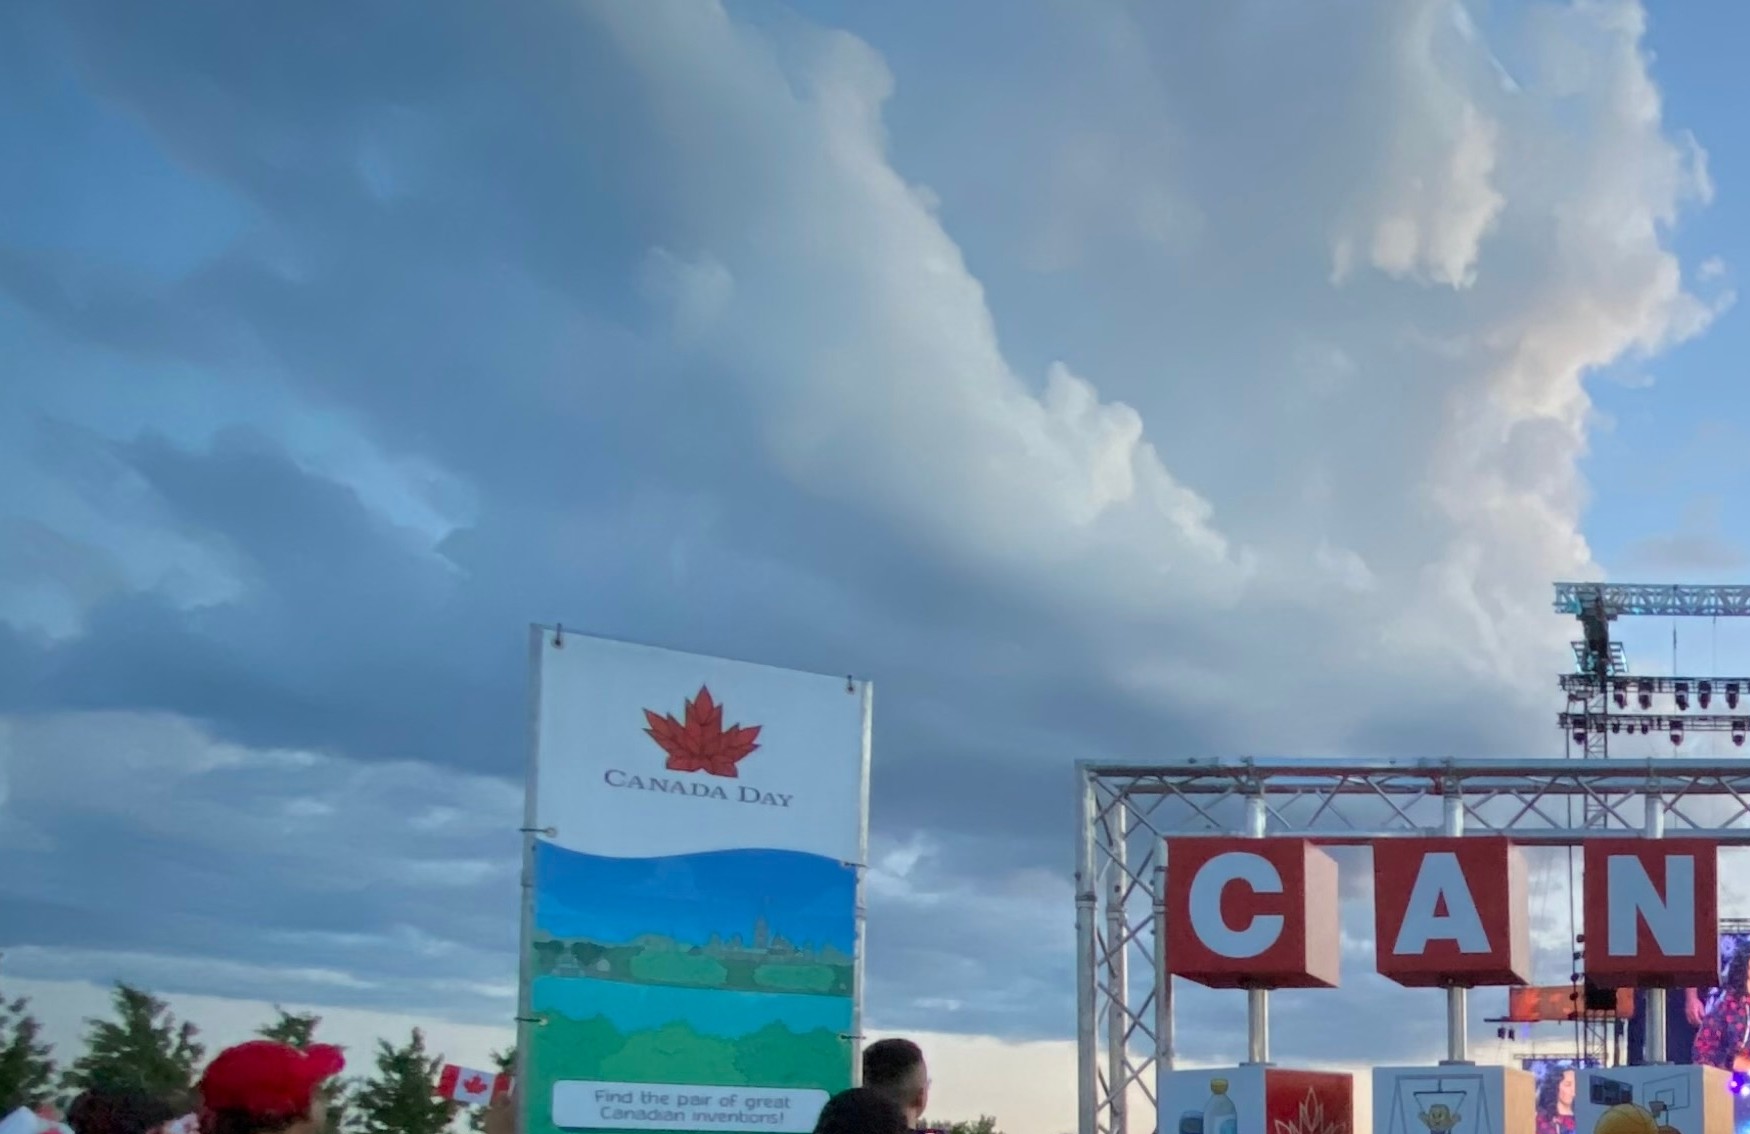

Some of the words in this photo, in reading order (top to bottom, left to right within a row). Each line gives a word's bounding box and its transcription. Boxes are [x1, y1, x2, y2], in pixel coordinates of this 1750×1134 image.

[603, 768, 727, 801] CANADA
[737, 785, 794, 808] DAY
[594, 1089, 632, 1105] Find
[640, 1090, 669, 1106] the
[677, 1093, 711, 1108] pair
[720, 1094, 738, 1107] of
[745, 1095, 791, 1111] great
[600, 1105, 685, 1123] Canadian
[693, 1110, 785, 1125] inventions!
